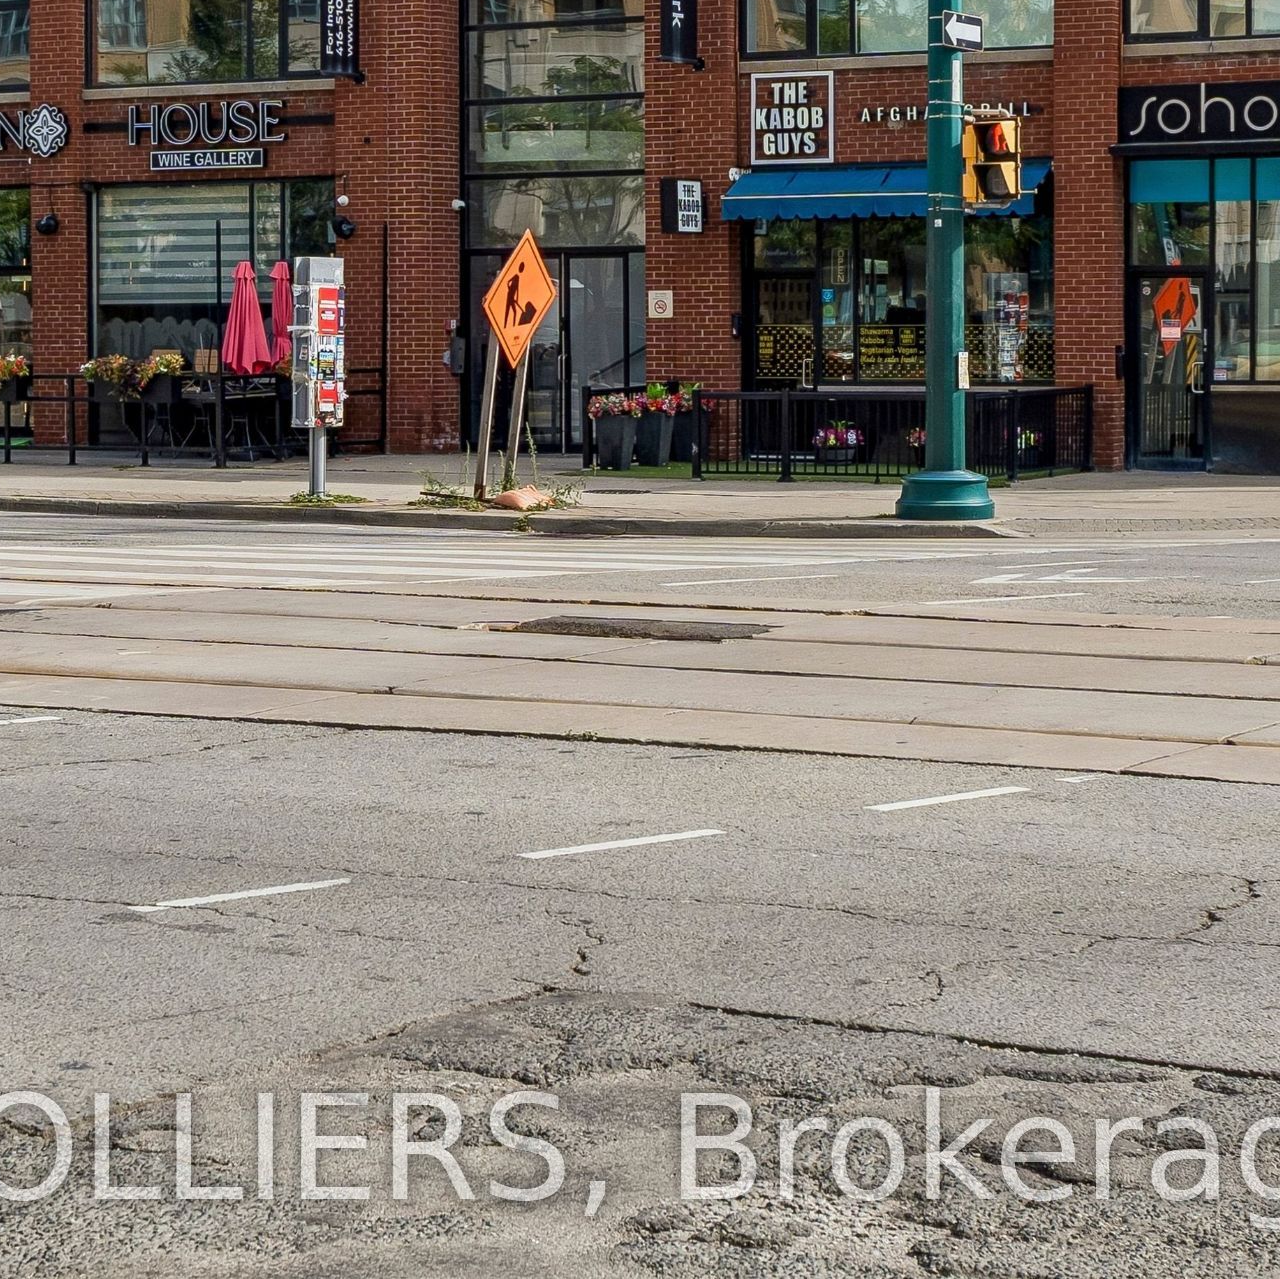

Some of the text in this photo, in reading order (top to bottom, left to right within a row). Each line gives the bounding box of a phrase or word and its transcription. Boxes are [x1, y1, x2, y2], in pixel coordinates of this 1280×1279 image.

[326, 31, 334, 55] For
[771, 81, 807, 105] THE
[755, 106, 824, 130] KABOB
[861, 106, 928, 122] AFGH
[1130, 82, 1278, 136] soho
[128, 100, 285, 146] HOUSE
[763, 131, 816, 156] GUYS
[158, 151, 255, 167] WINE GALLERY
[683, 184, 695, 197] THE
[678, 199, 700, 213] KABOB
[681, 213, 699, 228] GUYS
[837, 250, 845, 283] OPEN
[897, 346, 918, 354] Vegan
